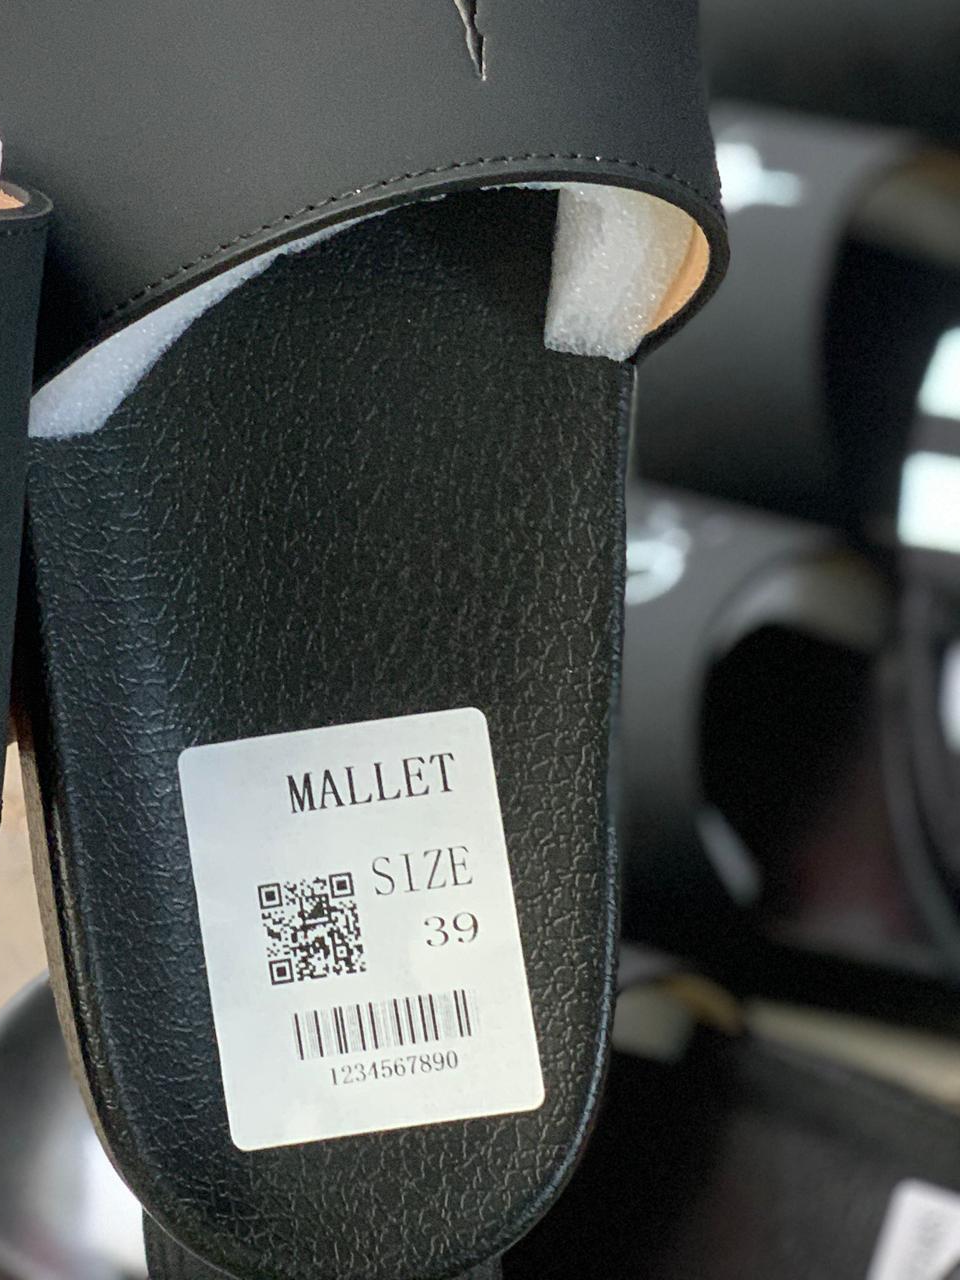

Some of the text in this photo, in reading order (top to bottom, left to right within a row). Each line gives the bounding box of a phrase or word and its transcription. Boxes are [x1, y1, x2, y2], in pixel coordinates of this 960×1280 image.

[286, 752, 455, 813] MALLET
[372, 845, 473, 896] SIZE
[423, 912, 479, 948] 39
[330, 1050, 459, 1086] 1234567890
